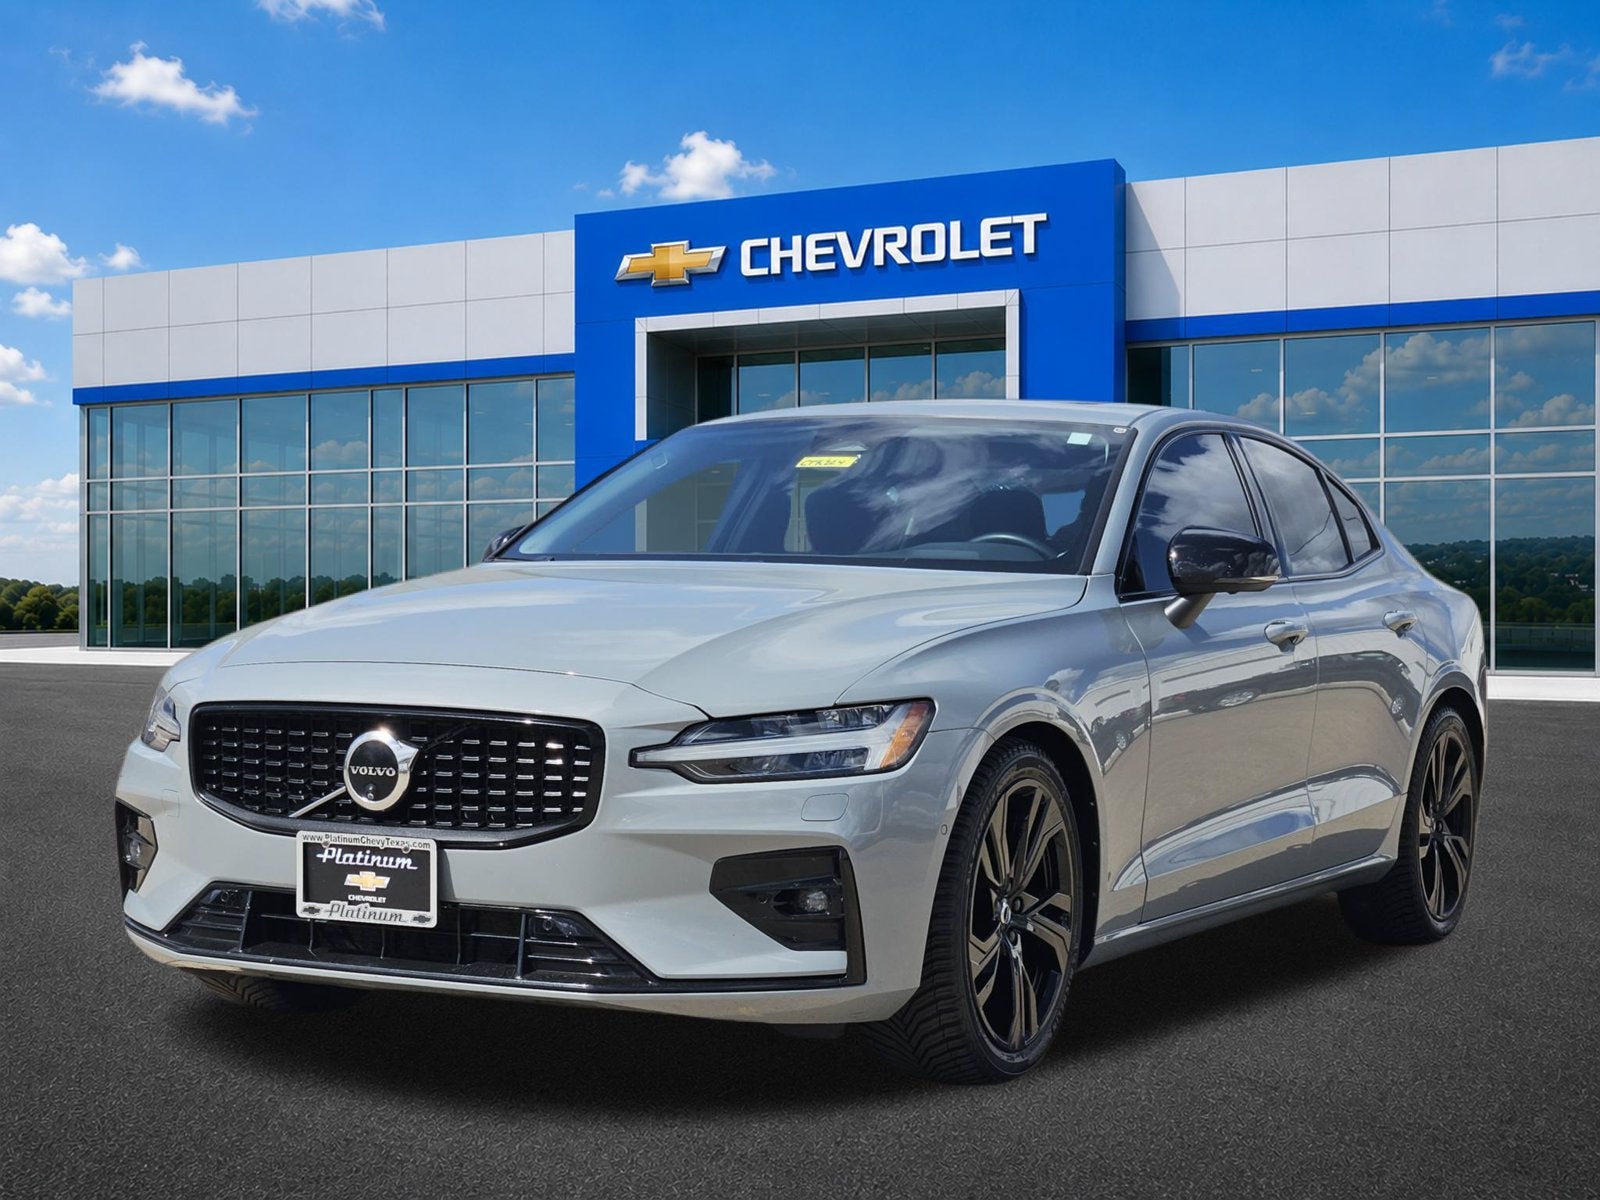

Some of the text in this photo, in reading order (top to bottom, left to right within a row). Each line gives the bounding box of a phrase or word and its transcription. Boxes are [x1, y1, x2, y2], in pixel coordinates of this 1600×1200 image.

[741, 212, 1048, 277] CHEVROLET
[350, 765, 396, 777] VOLVO
[302, 833, 431, 849] wwwPlatinumChevyTexas.com
[316, 847, 418, 870] Platinum
[347, 894, 387, 903] CHEVROLET
[324, 902, 409, 923] Platinum
